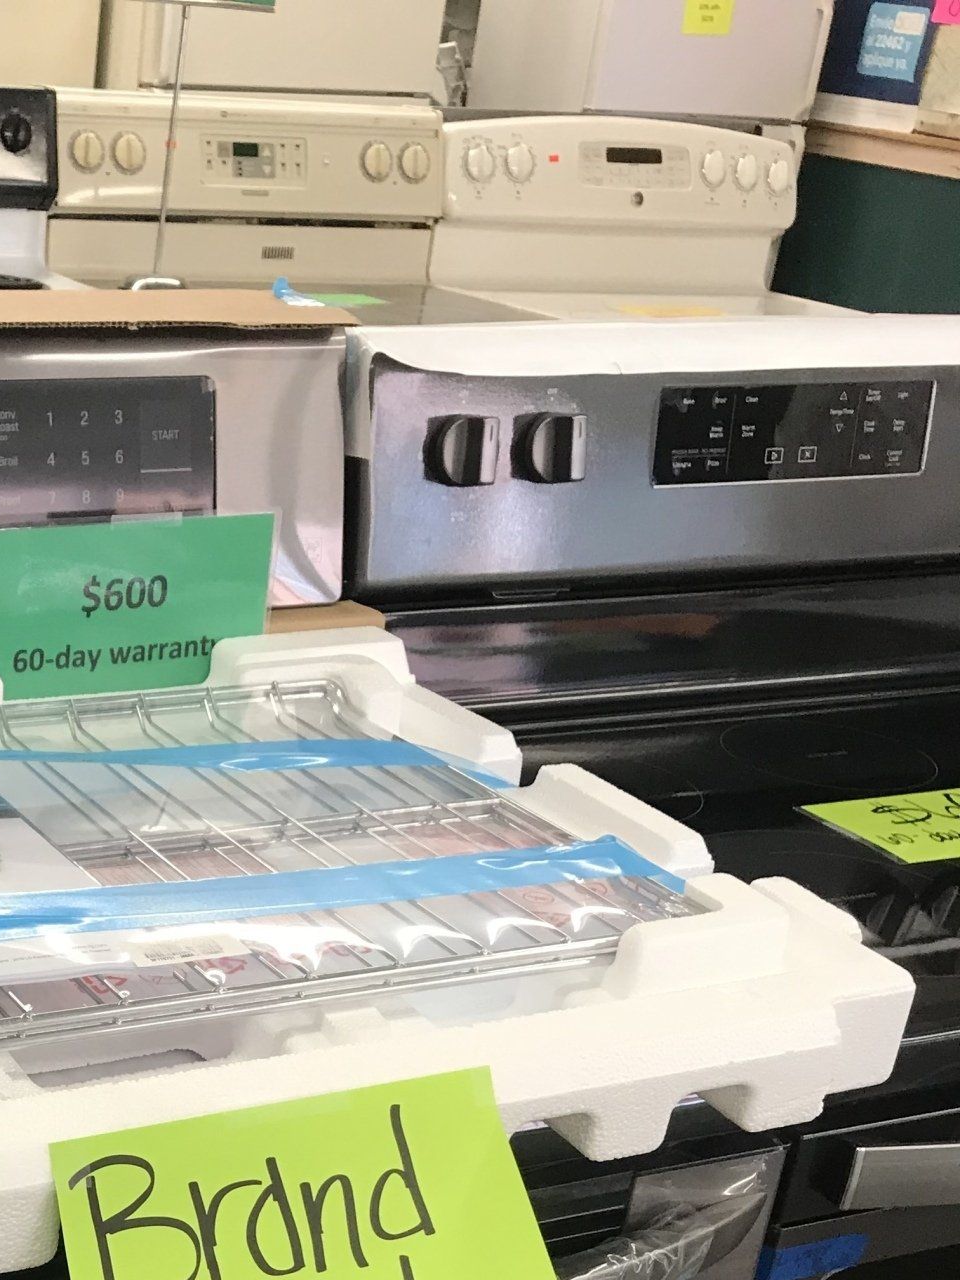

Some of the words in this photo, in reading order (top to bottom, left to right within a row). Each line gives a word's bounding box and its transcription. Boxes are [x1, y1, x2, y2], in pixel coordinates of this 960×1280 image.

[46, 412, 54, 426] 1
[80, 411, 89, 426] 2
[115, 410, 123, 424] 3
[151, 429, 180, 441] START
[47, 452, 55, 467] 4
[81, 451, 90, 465] 5
[115, 449, 124, 464] 6
[82, 489, 91, 504] 8
[116, 488, 124, 502] 9
[81, 574, 168, 618] $600
[12, 645, 102, 673] 60-day
